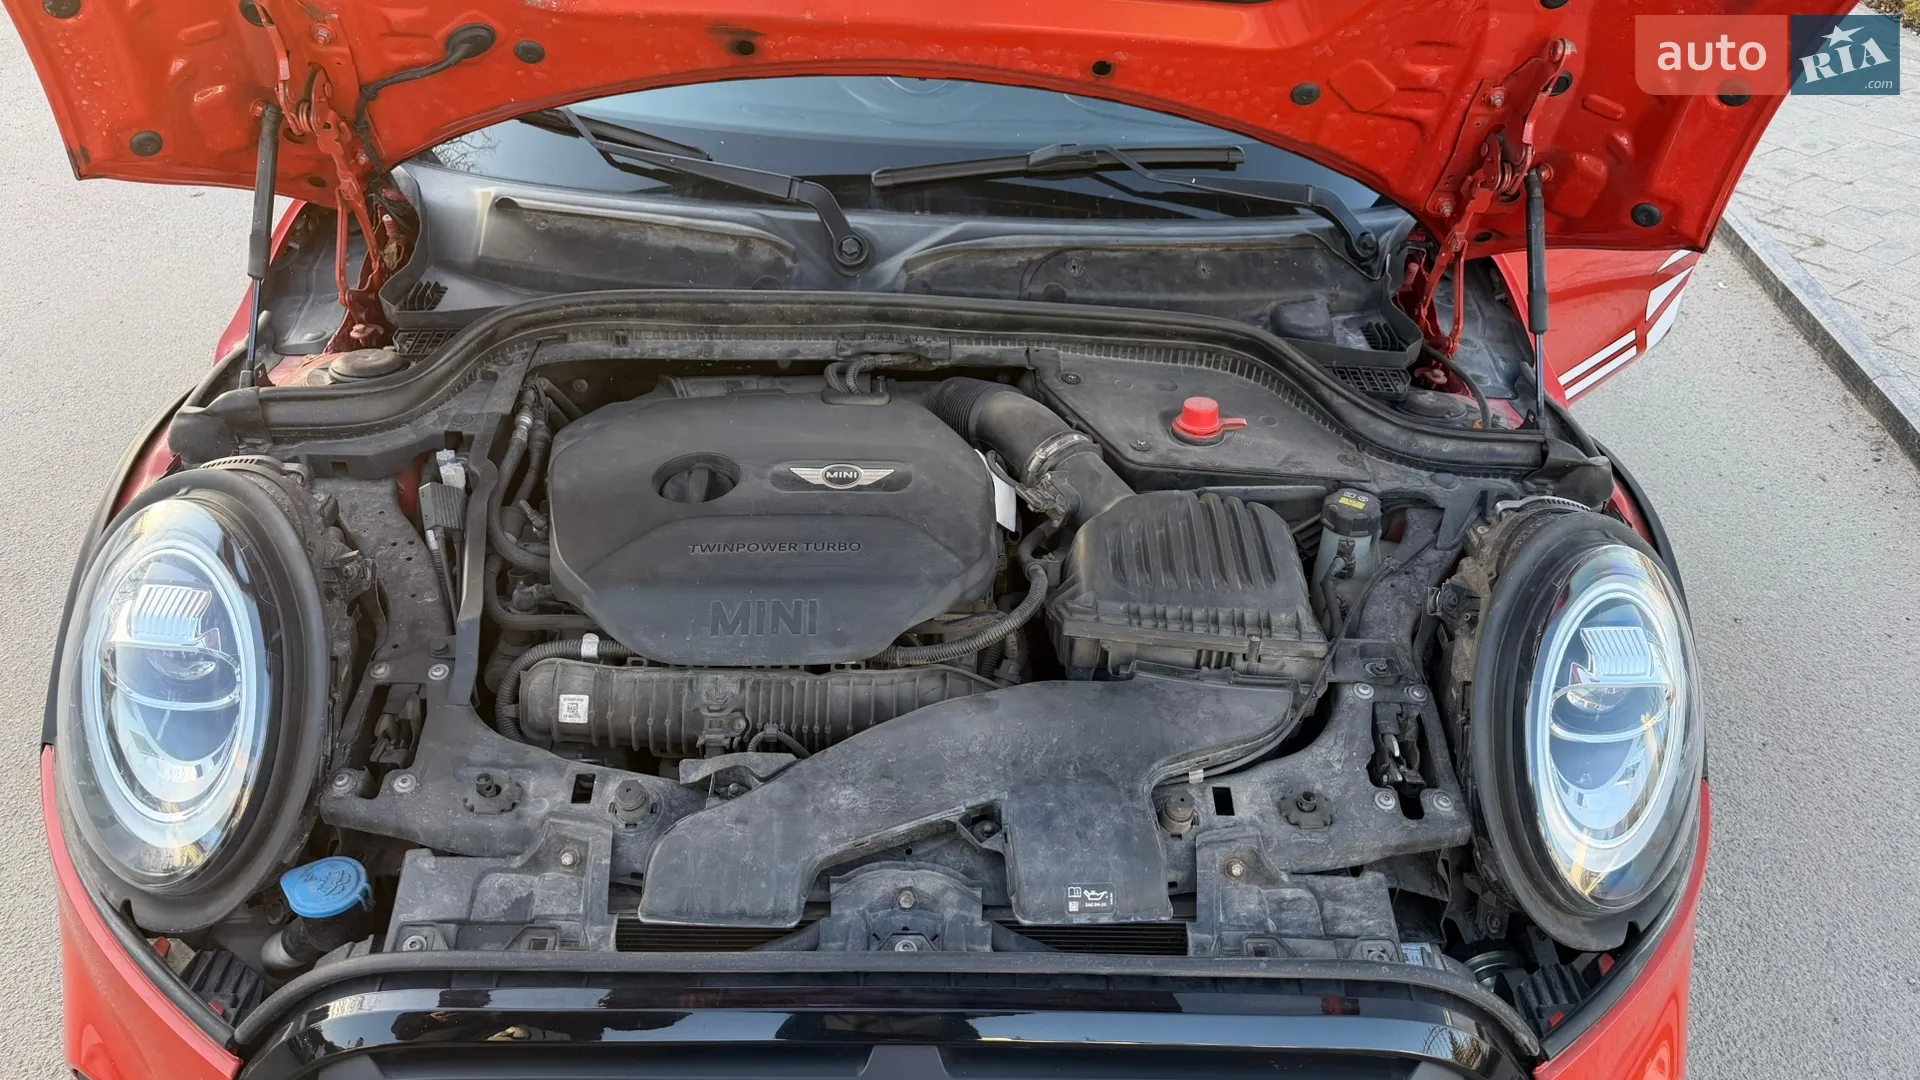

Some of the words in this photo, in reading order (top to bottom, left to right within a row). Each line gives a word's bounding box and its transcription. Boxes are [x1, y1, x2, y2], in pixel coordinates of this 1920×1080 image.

[826, 470, 858, 480] MINI
[689, 542, 798, 554] TWINPOWER
[804, 541, 862, 552] TURBO
[709, 599, 819, 637] MINI
